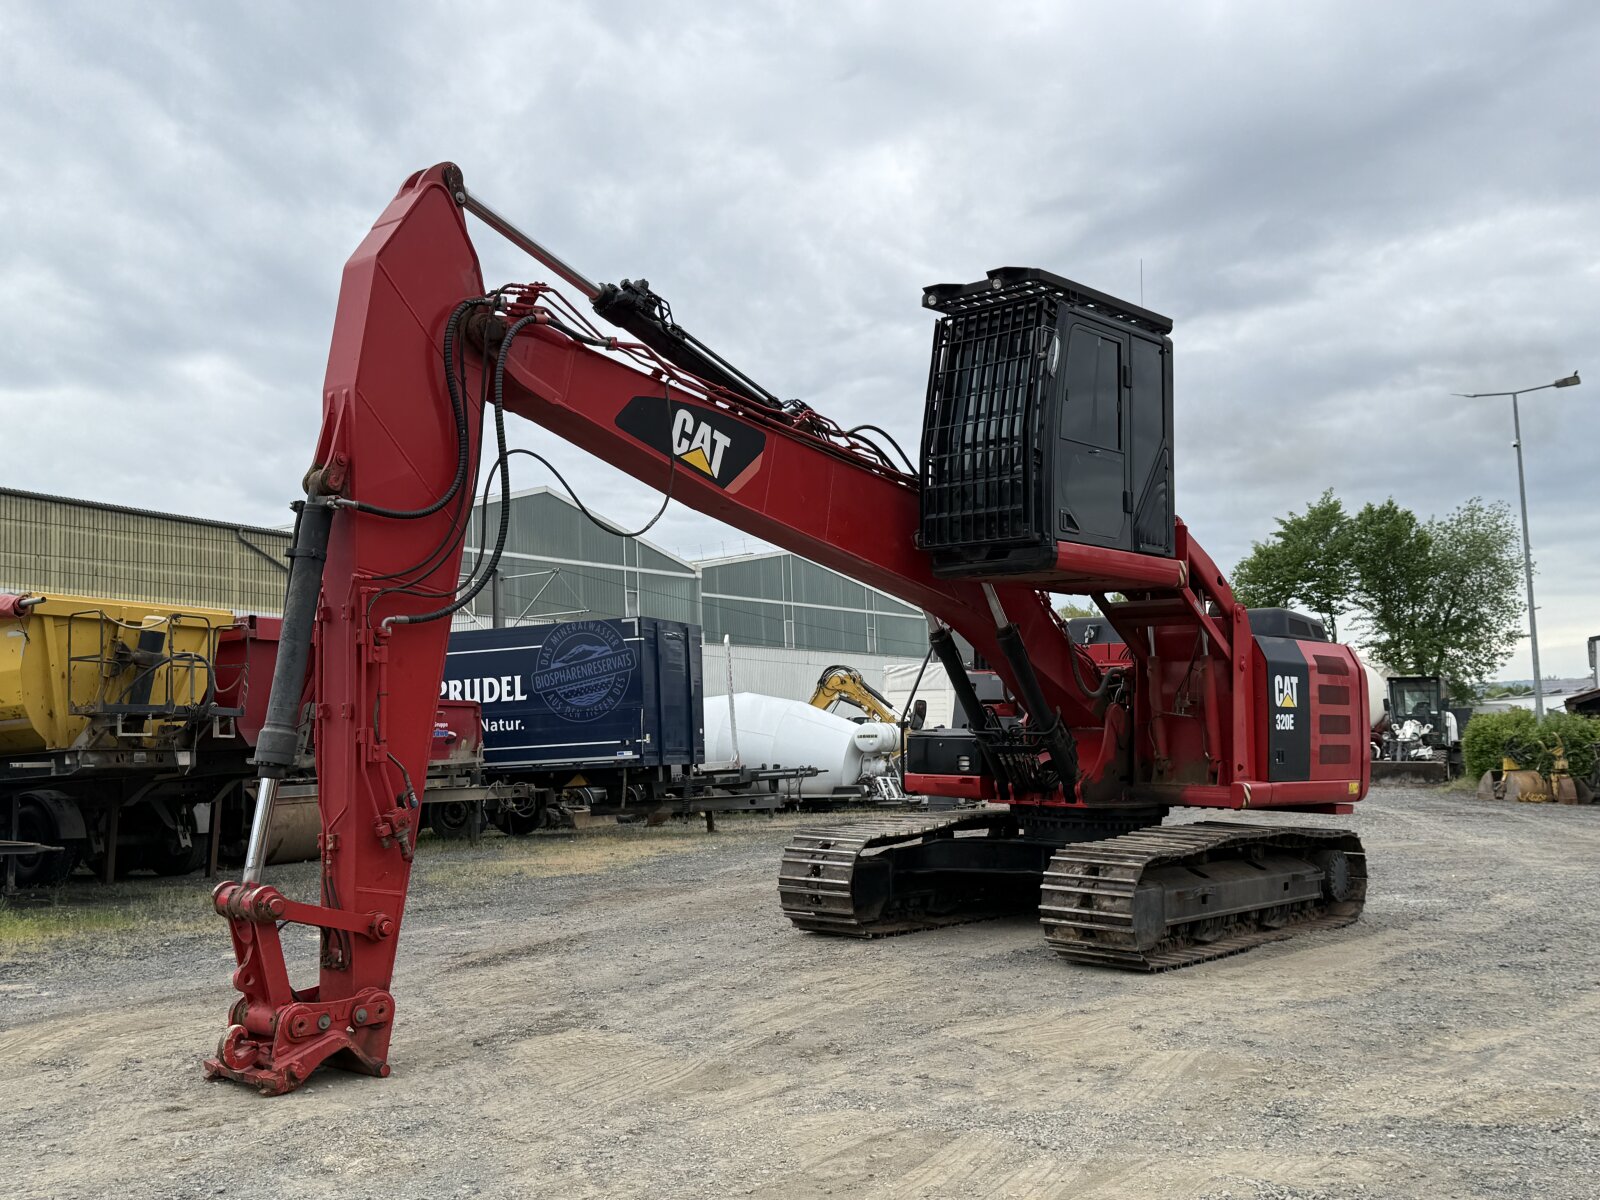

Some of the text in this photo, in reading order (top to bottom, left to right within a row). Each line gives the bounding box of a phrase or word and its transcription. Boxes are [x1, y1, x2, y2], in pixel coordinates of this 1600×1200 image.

[672, 409, 731, 478] CAT
[541, 622, 619, 666] DAS MINERALWASSER
[547, 693, 564, 710] AUS
[613, 677, 626, 696] DES
[1274, 675, 1298, 708] CAT
[1275, 714, 1294, 730] 320E
